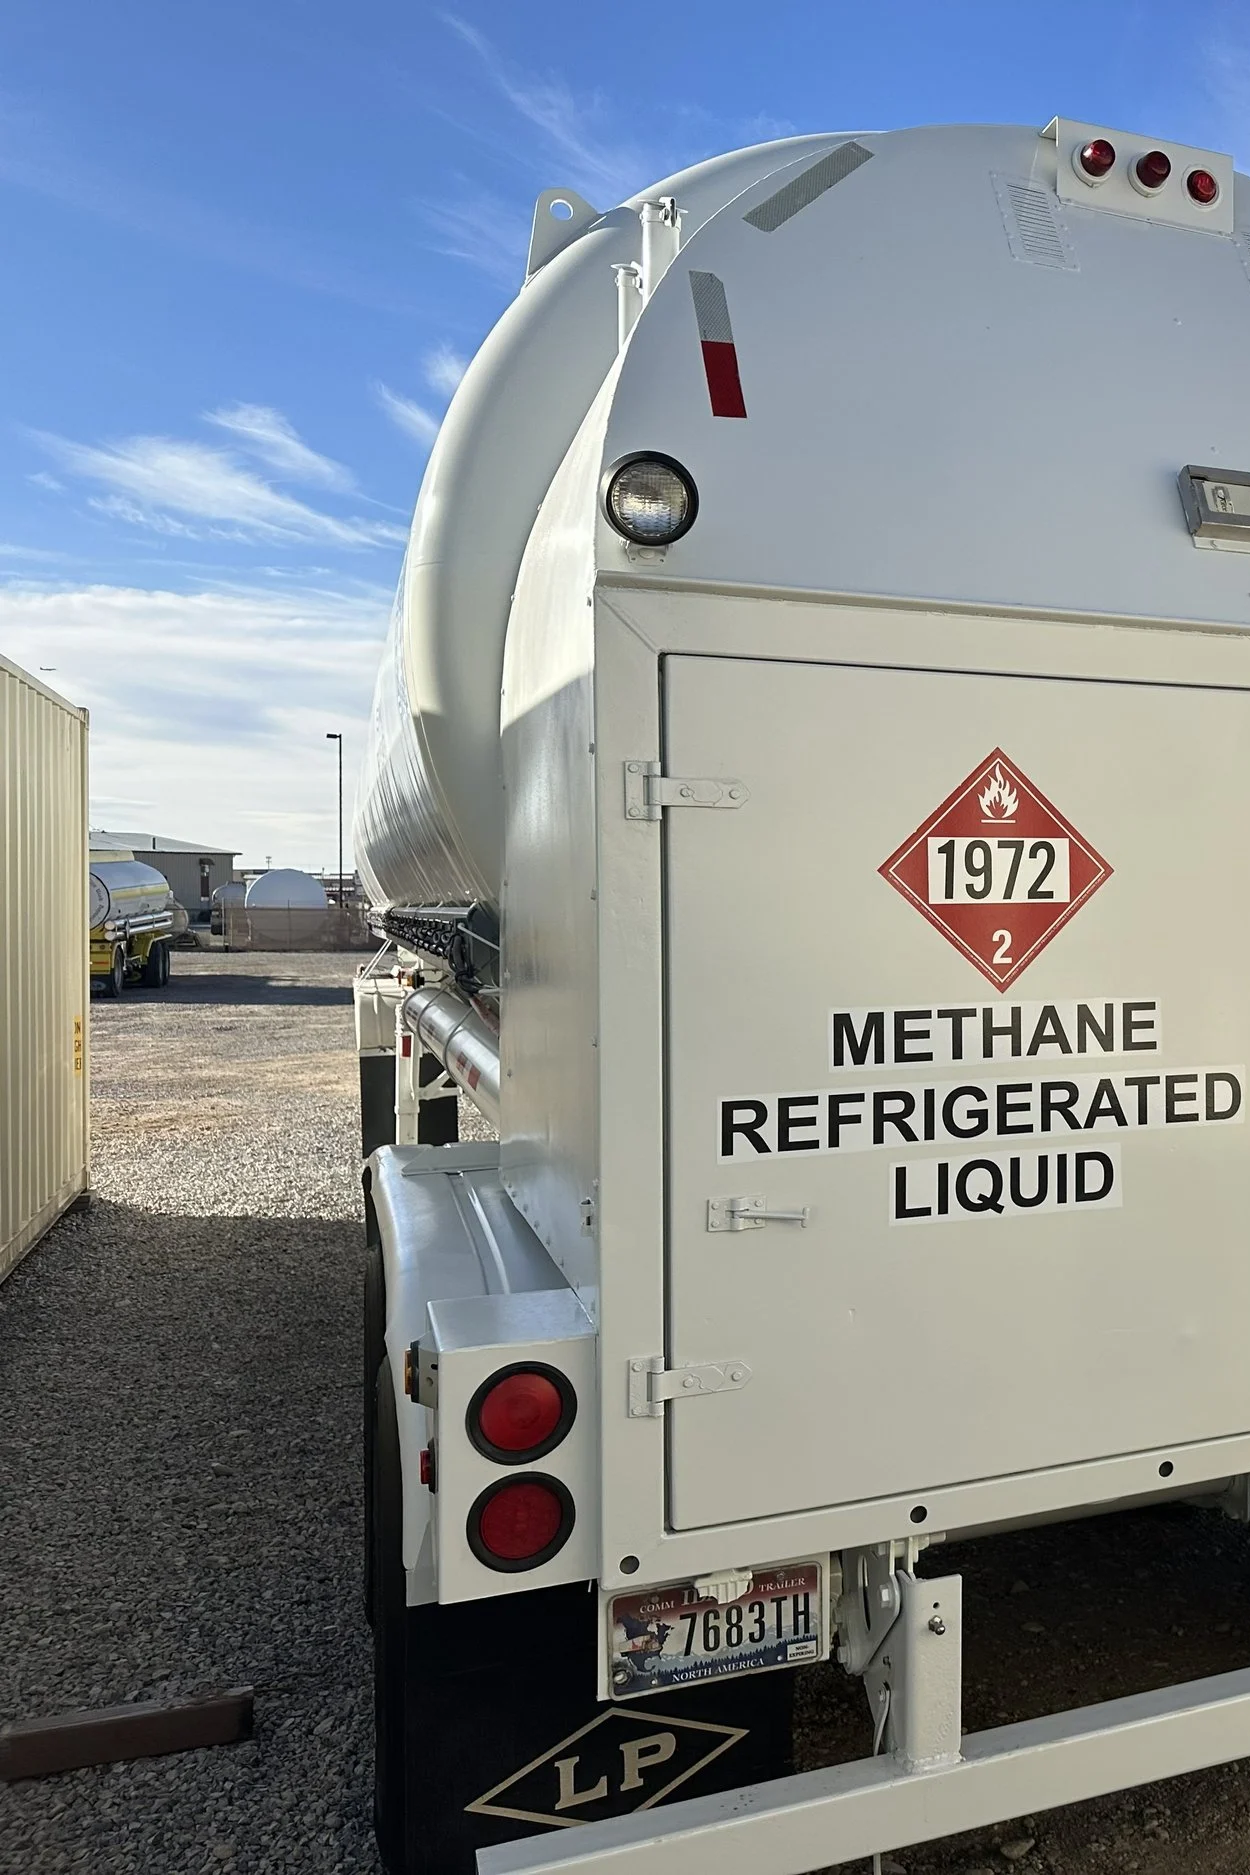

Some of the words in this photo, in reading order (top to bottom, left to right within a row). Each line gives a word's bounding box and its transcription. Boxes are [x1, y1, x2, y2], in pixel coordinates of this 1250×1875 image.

[936, 839, 1057, 900] 1972
[991, 929, 1013, 964] 2
[832, 1001, 1158, 1067] METHANE
[720, 1072, 1242, 1157] REFRIGERATED
[894, 1151, 1114, 1220] LIQUID
[639, 1599, 675, 1614] COMM
[758, 1577, 806, 1593] TRAILER
[679, 1592, 811, 1657] 7683TH
[671, 1667, 712, 1683] NORTH
[715, 1657, 765, 1675] AMERICA
[554, 1731, 677, 1811] LP
